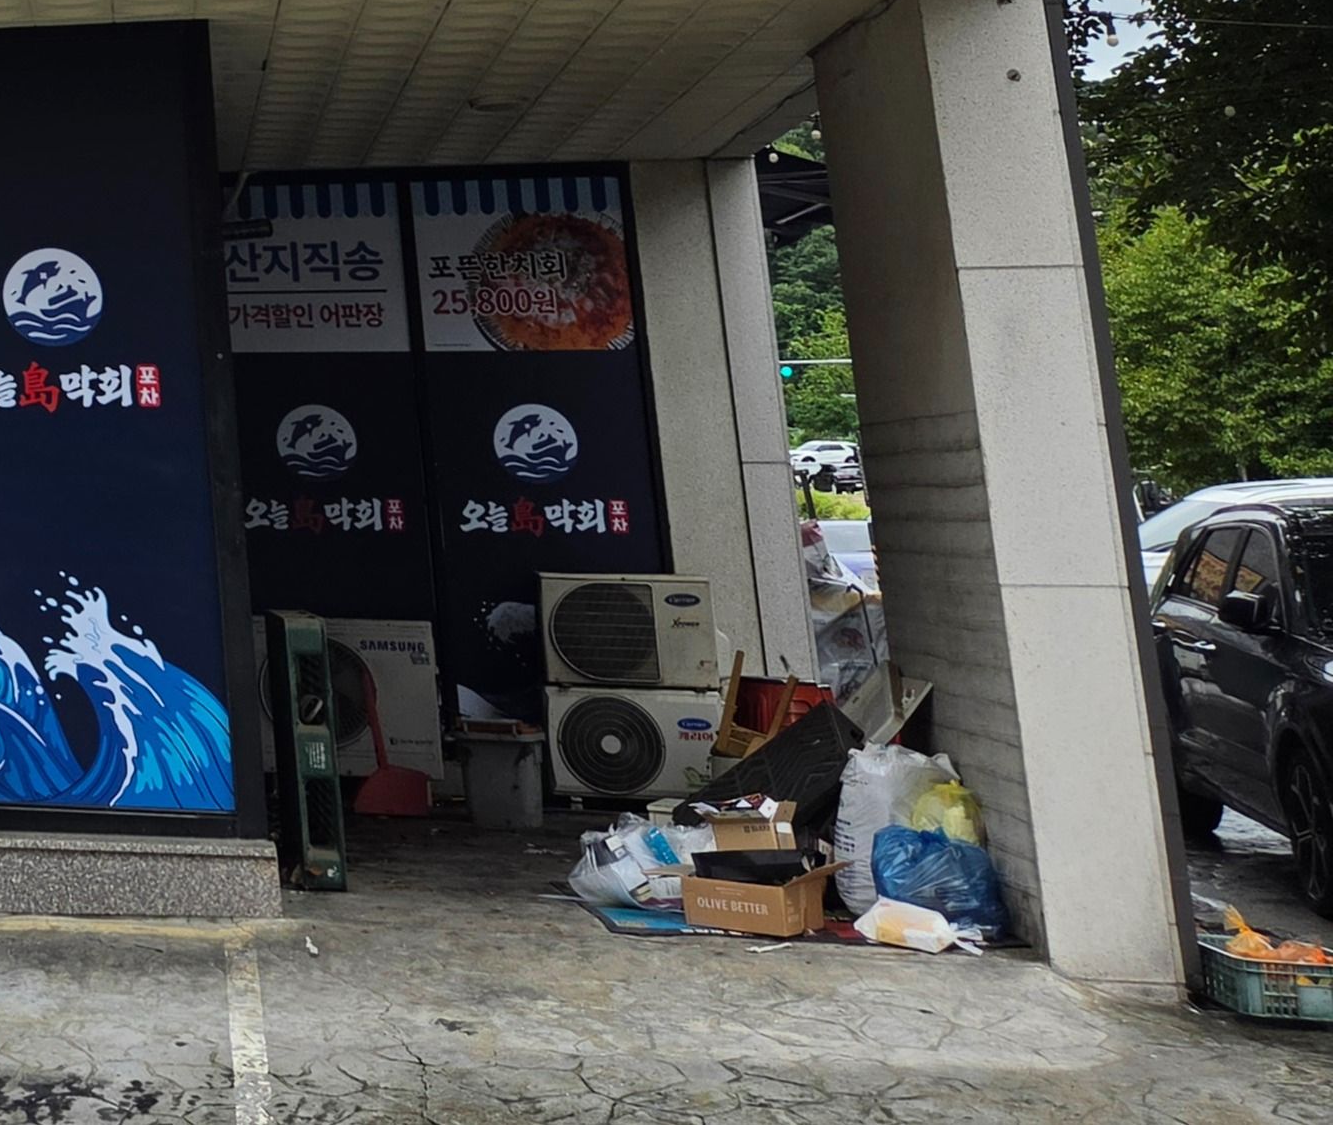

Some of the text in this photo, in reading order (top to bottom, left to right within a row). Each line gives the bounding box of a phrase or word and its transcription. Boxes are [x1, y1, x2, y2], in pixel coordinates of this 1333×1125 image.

[226, 240, 384, 282] 산지직송
[429, 251, 566, 281] 포뜬한치회
[433, 288, 556, 315] 25,800원
[230, 302, 385, 329] 가격할인 어판장
[360, 640, 425, 652] SAMSUNG
[697, 896, 729, 912] OLIVE
[731, 899, 769, 916] BETTER
